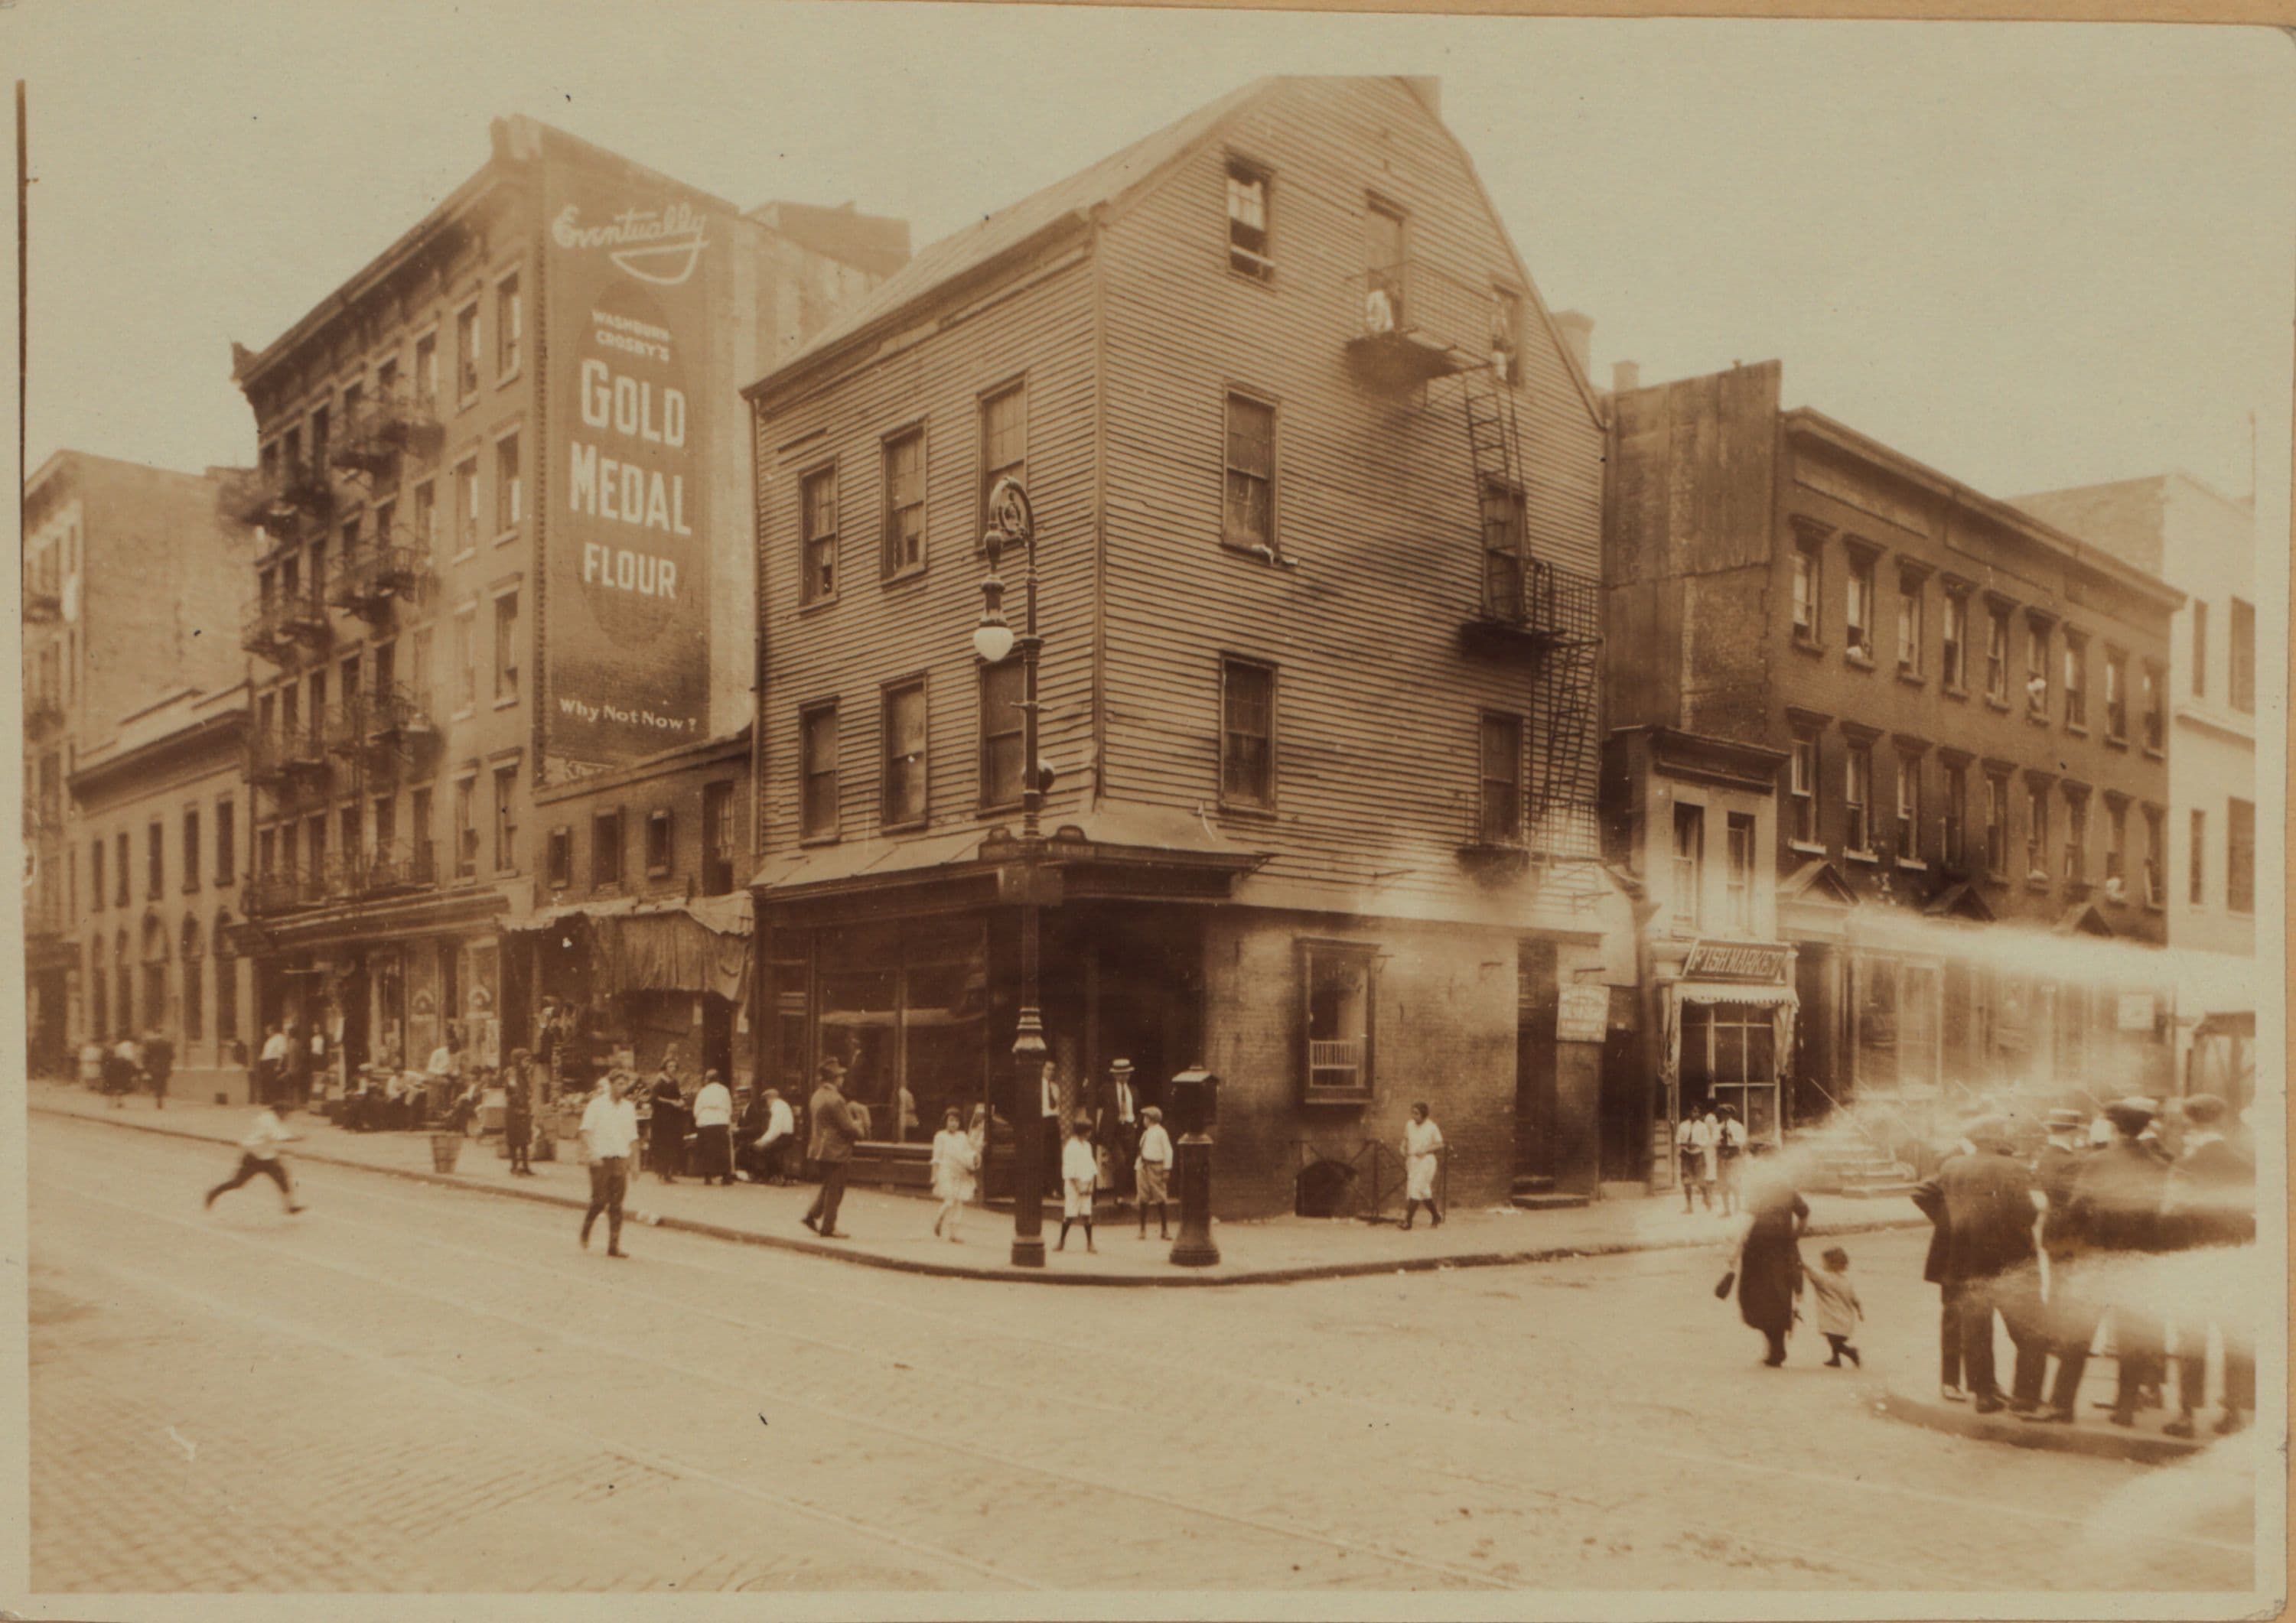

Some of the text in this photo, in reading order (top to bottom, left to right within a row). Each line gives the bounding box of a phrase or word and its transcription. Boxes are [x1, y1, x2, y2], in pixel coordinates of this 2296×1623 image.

[552, 203, 709, 285] Eventually
[581, 358, 687, 448] GOLD
[569, 441, 692, 536] MEDAL
[583, 542, 677, 600] FLOUR
[559, 698, 600, 724] Why
[603, 704, 640, 724] Not
[641, 711, 684, 730] Now
[1689, 945, 1785, 977] FISH MARKET
